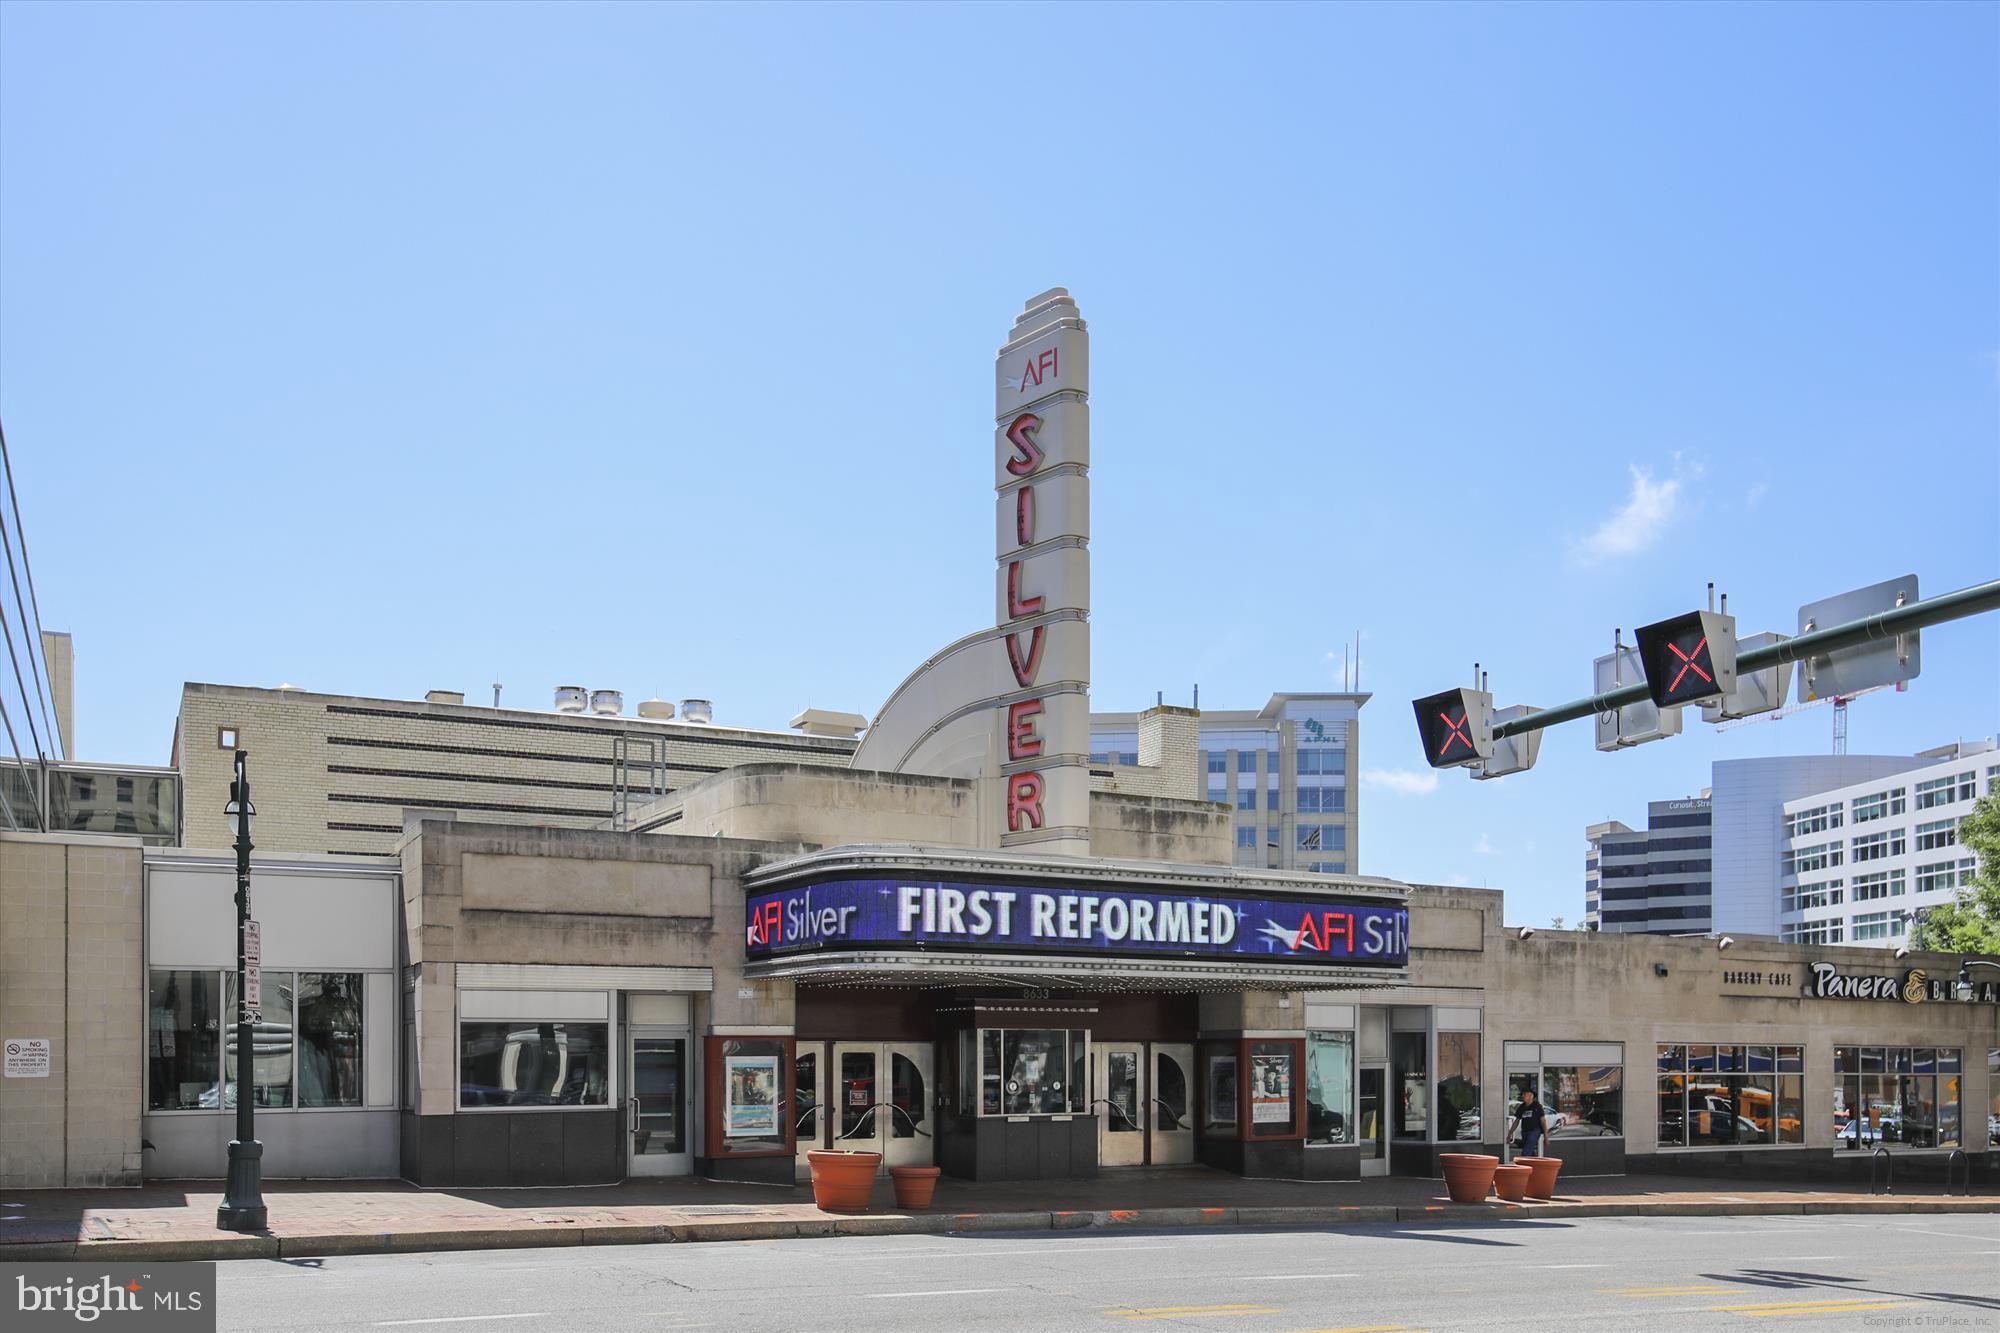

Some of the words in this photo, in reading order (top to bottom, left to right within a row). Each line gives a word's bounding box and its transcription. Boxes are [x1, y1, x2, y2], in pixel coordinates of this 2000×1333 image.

[1021, 347, 1058, 393] AFI
[1006, 412, 1047, 833] SILVER
[748, 901, 782, 946] AFI
[787, 886, 857, 941] Silver
[898, 887, 1016, 936] FIRST
[1031, 894, 1236, 945] REFORMED
[1292, 912, 1354, 953] AFI
[1023, 989, 1049, 999] 8633
[1723, 971, 1763, 985] BAKERY
[1812, 961, 1898, 999] Panera
